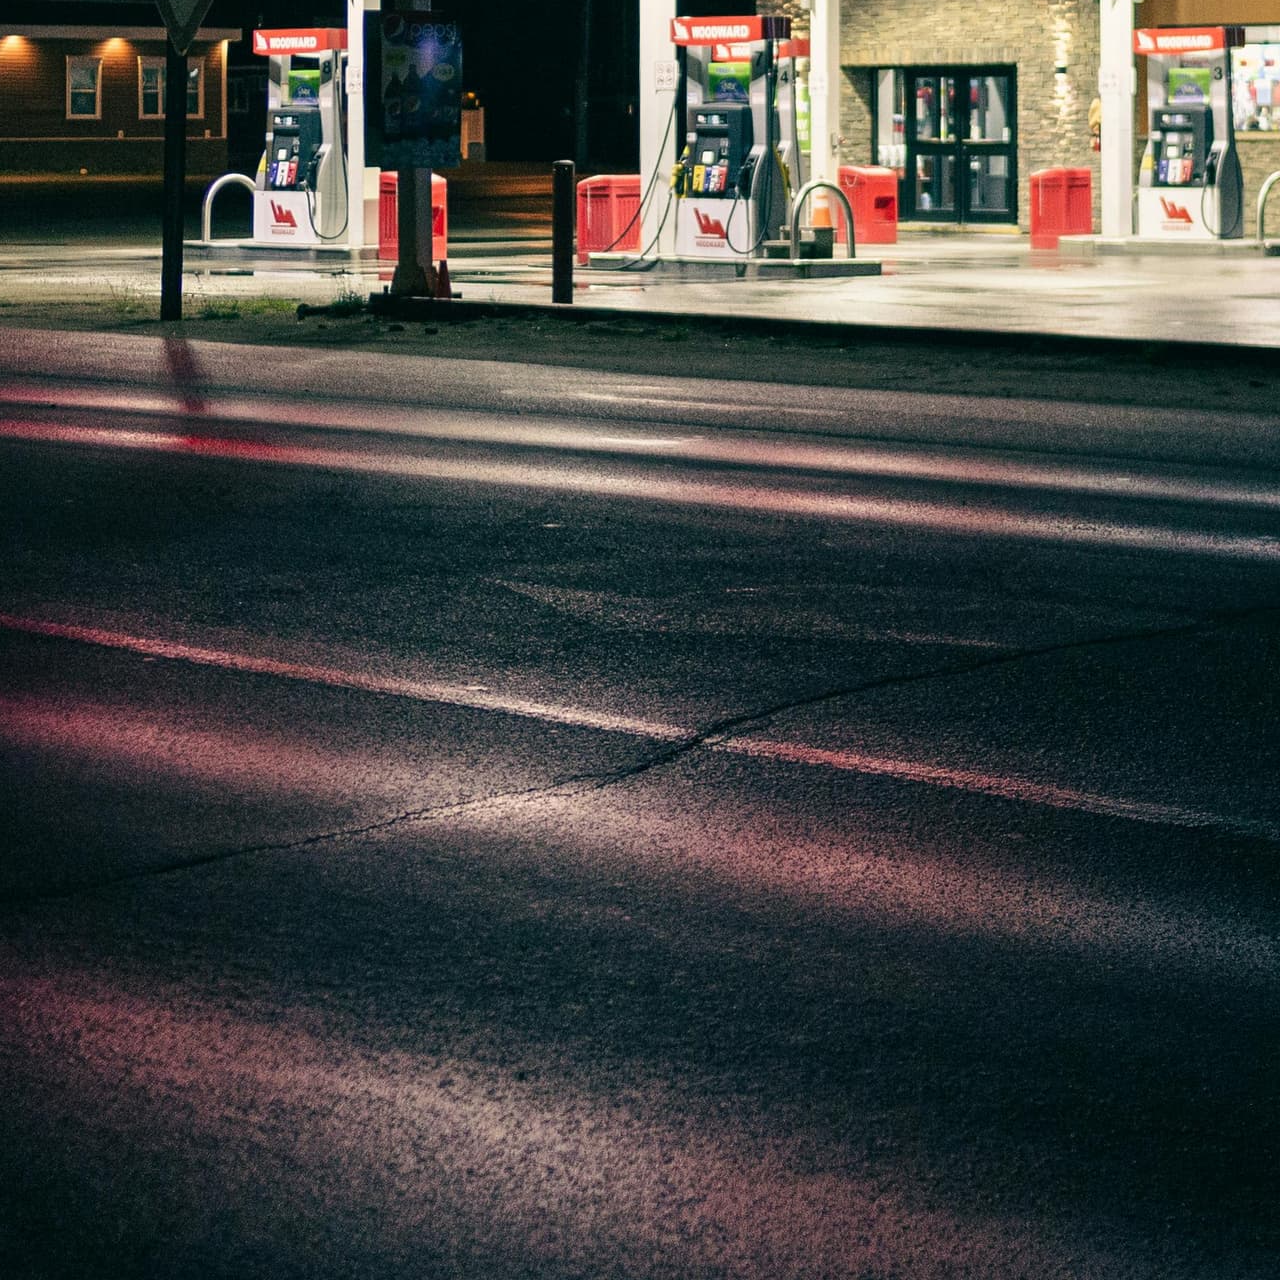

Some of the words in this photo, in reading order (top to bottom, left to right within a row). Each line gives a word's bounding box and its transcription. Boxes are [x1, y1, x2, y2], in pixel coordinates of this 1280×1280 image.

[410, 20, 457, 41] pepsi
[691, 24, 750, 39] WOODWARD
[269, 36, 317, 50] WOODWARD
[781, 70, 789, 82] 4
[1213, 66, 1223, 80] 3
